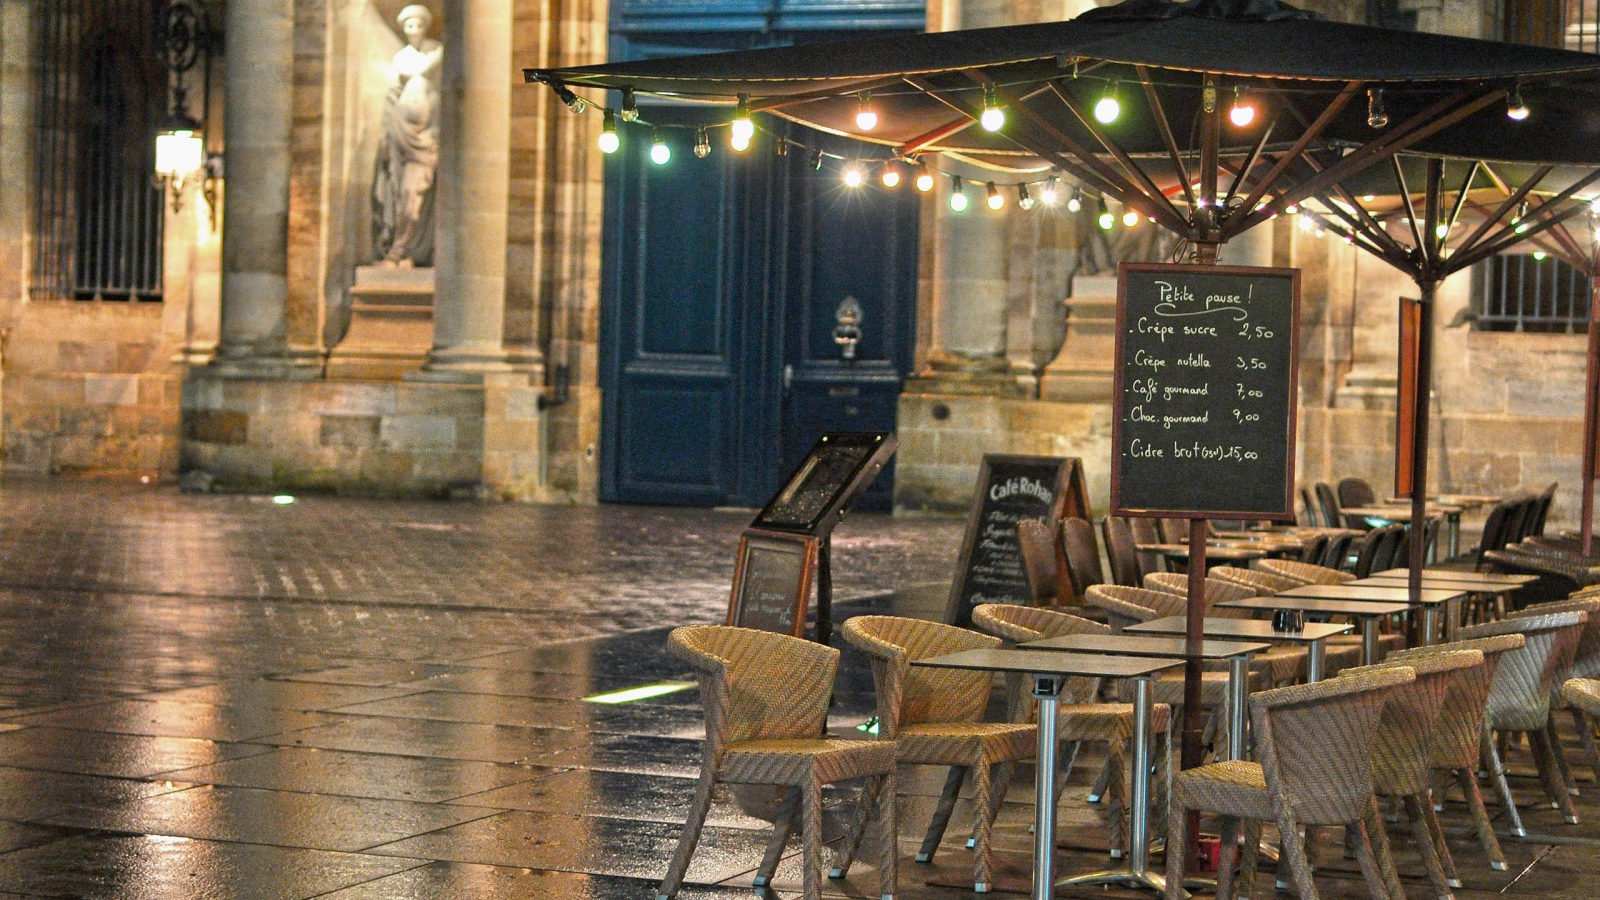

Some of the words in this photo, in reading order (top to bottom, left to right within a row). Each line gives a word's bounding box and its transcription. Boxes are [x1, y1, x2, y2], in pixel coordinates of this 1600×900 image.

[1154, 280, 1195, 302] Petite
[1205, 294, 1242, 310] pause
[1248, 283, 1253, 304] !
[1183, 324, 1219, 337] sucre
[1238, 322, 1274, 341] 2,50
[1177, 352, 1211, 368] nutella
[1236, 356, 1267, 371] 3,50
[1132, 377, 1158, 403] Café
[1163, 382, 1209, 401] gourmand
[1236, 383, 1264, 400] 7,00
[1130, 405, 1160, 422] Choc.
[1163, 410, 1209, 429] gourmand
[1232, 408, 1260, 424] 9,00
[1130, 438, 1164, 458] Cidre
[1174, 441, 1200, 459] brut
[1224, 446, 1258, 462] 15,00
[990, 478, 1019, 501] Café
[1019, 476, 1053, 504] Rohan
